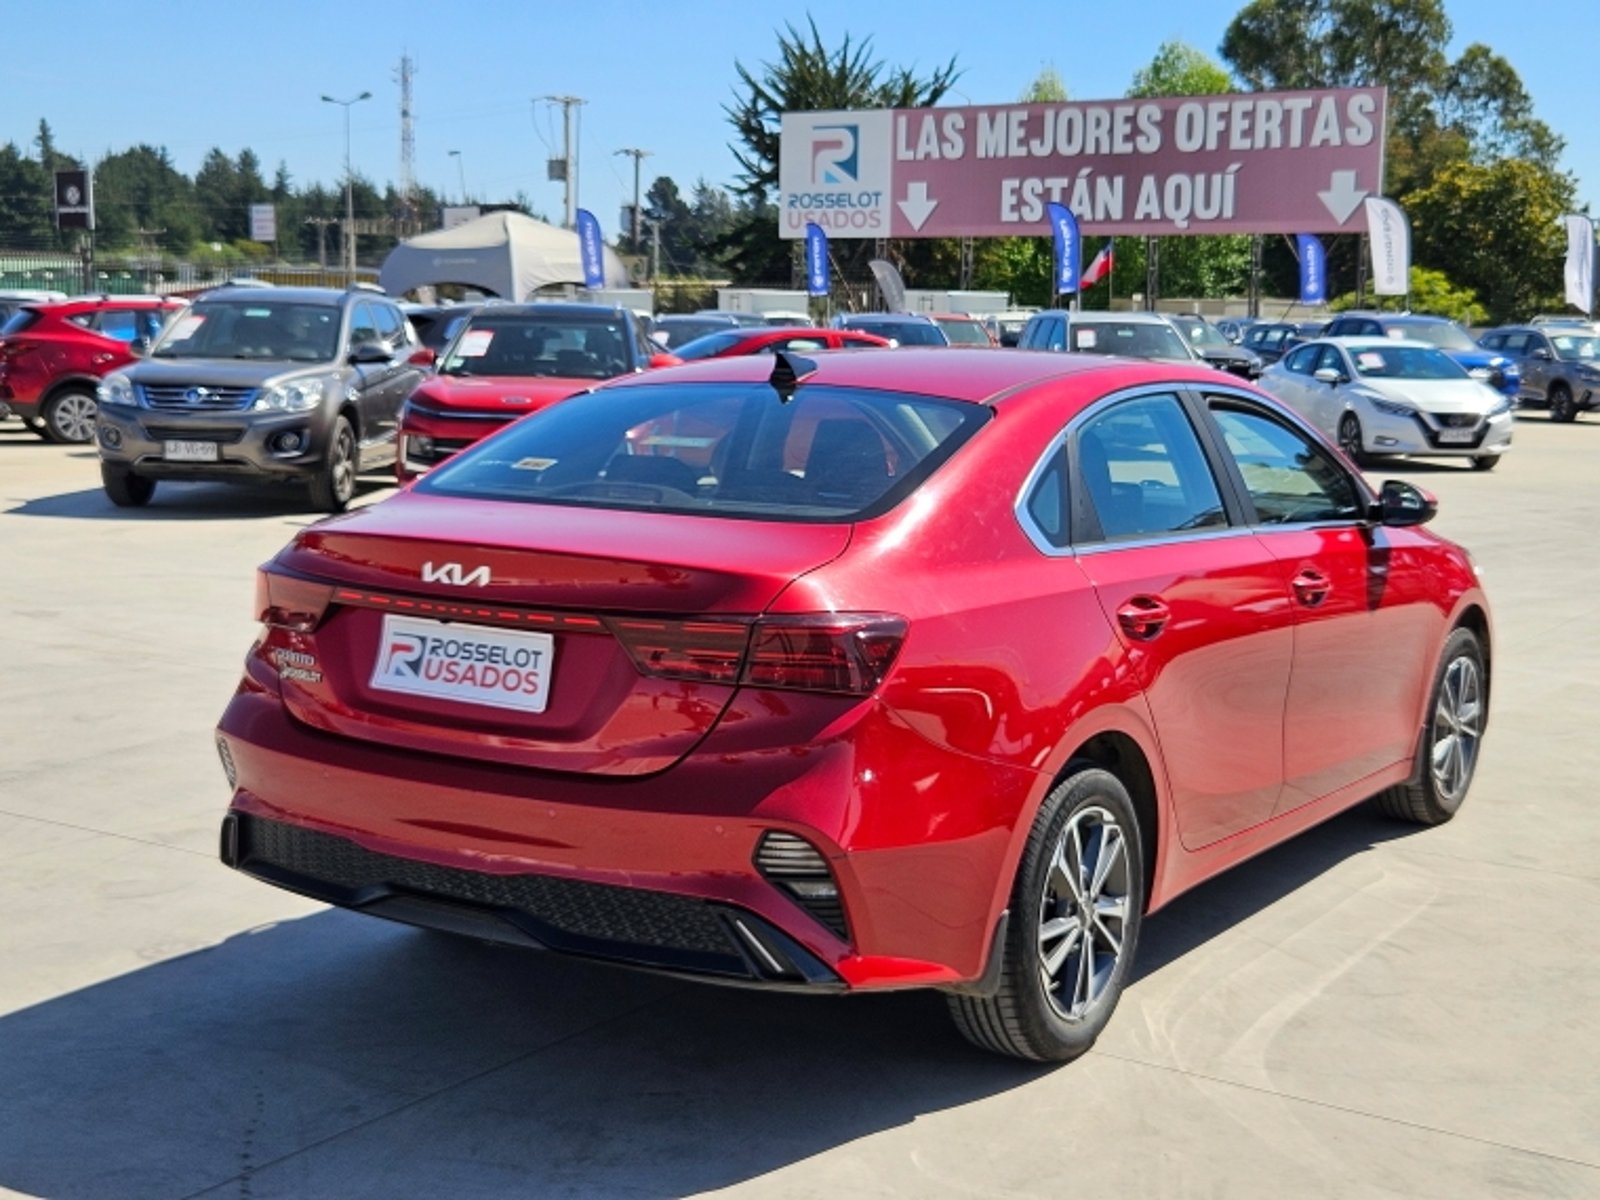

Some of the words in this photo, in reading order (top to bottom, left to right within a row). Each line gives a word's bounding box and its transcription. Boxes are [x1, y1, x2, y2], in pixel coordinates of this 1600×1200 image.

[896, 112, 965, 161] LAS
[976, 104, 1162, 159] MEJORES
[1174, 93, 1376, 152] OFERTAS
[787, 190, 882, 210] ROSSELOT
[1001, 167, 1123, 222] ESTÁN
[1134, 162, 1243, 229] AQUÍ
[787, 209, 881, 230] USADOS
[422, 561, 491, 588] KIA
[429, 637, 543, 670] ROSSELOT
[423, 658, 540, 695] USADOS
